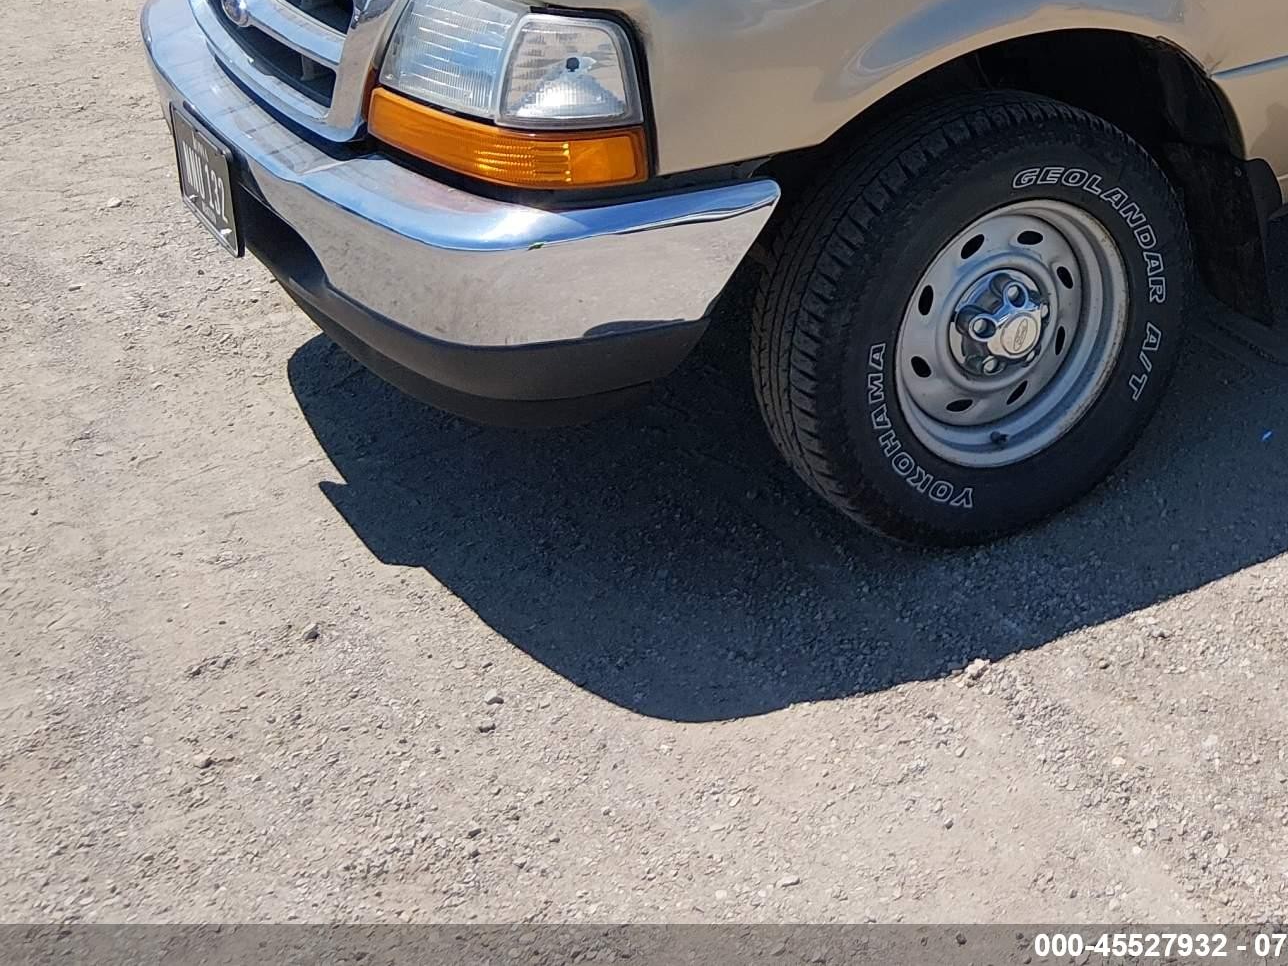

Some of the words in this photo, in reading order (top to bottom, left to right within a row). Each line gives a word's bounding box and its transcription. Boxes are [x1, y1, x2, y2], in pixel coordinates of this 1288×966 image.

[204, 164, 229, 224] 132
[1012, 166, 1166, 304] GEOLANDAR
[1131, 322, 1161, 400] A/T
[867, 343, 973, 509] YOKOHAMA
